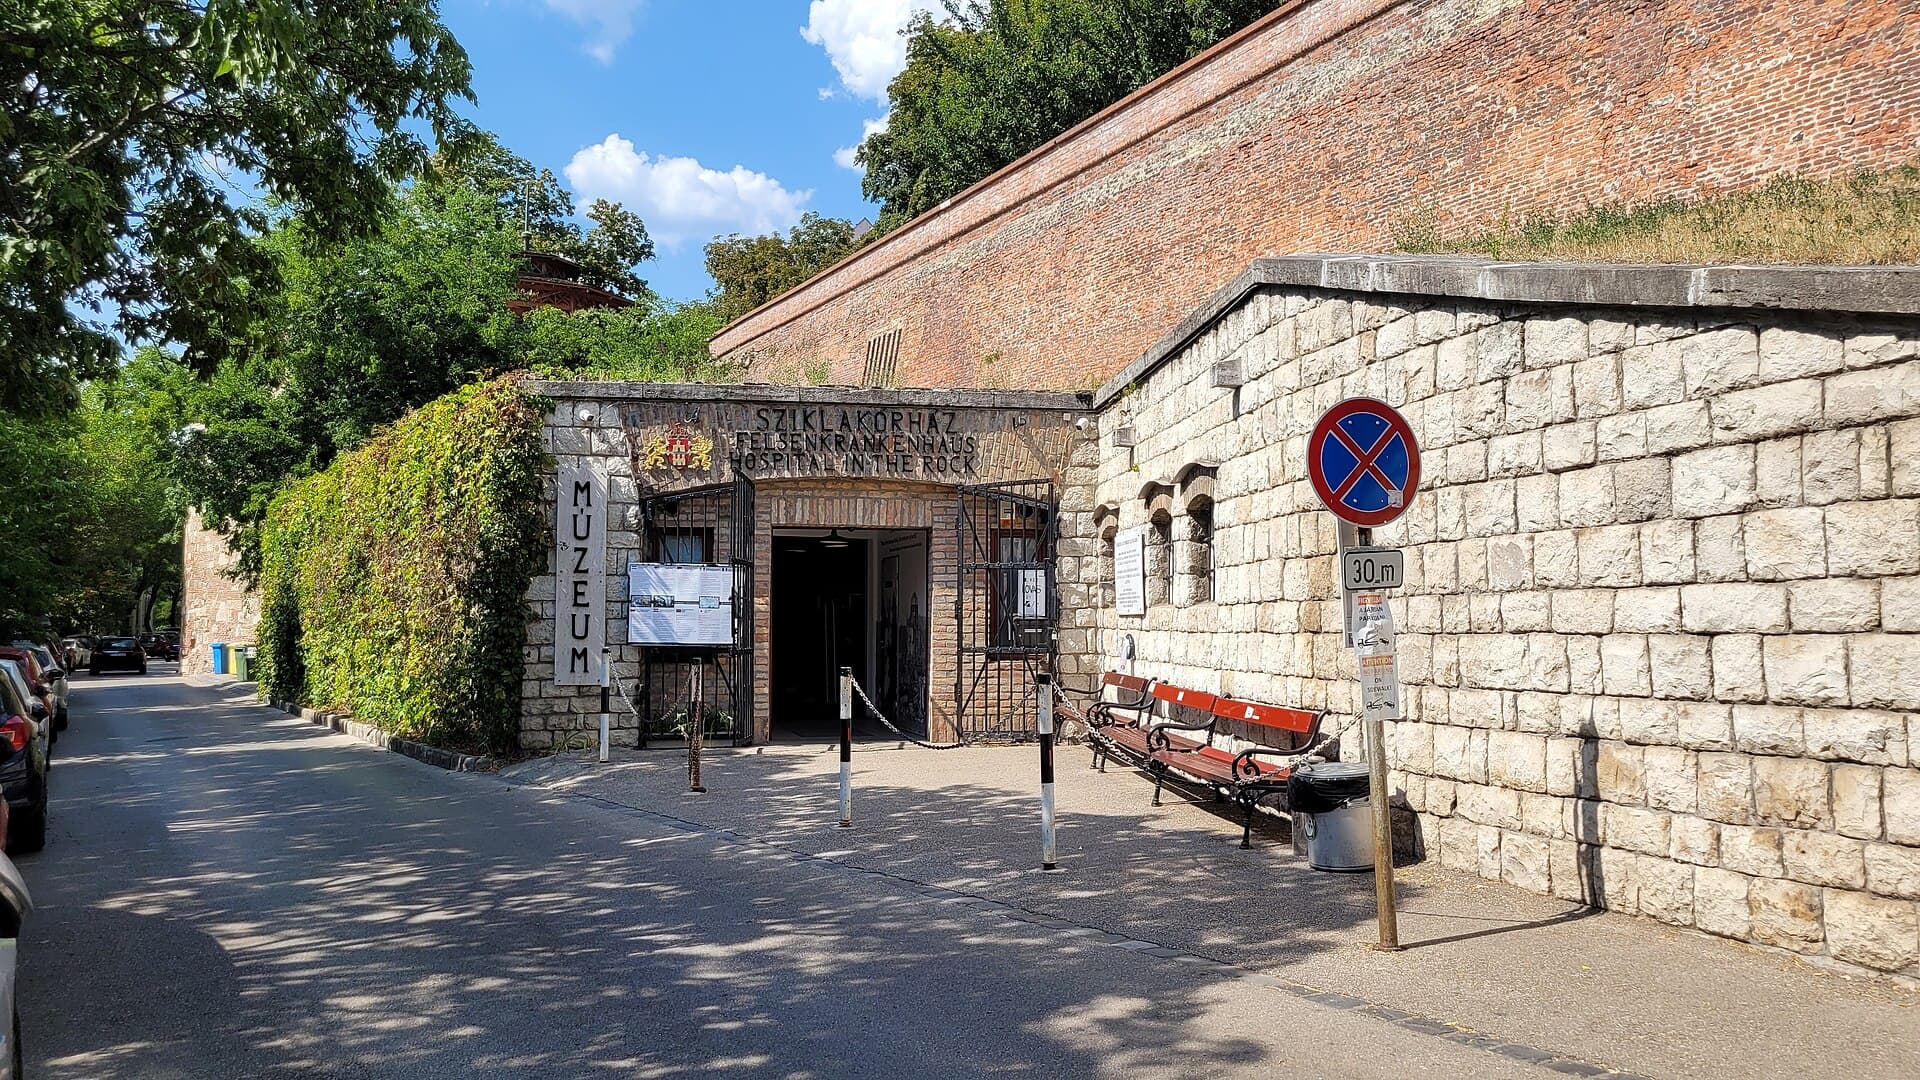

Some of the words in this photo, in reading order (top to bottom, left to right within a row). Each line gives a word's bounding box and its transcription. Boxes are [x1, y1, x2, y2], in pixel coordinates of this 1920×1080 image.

[756, 407, 958, 435] SZIKLAKÓRHÁZ
[736, 431, 975, 454] FELSENKRANKENHAUS
[729, 451, 836, 471] HOSPITAL
[844, 453, 865, 472] IN
[872, 454, 913, 472] THE
[923, 455, 976, 473] ROCK
[570, 480, 592, 673] MÚZEUM
[1353, 558, 1374, 583] 30
[1381, 564, 1394, 581] m
